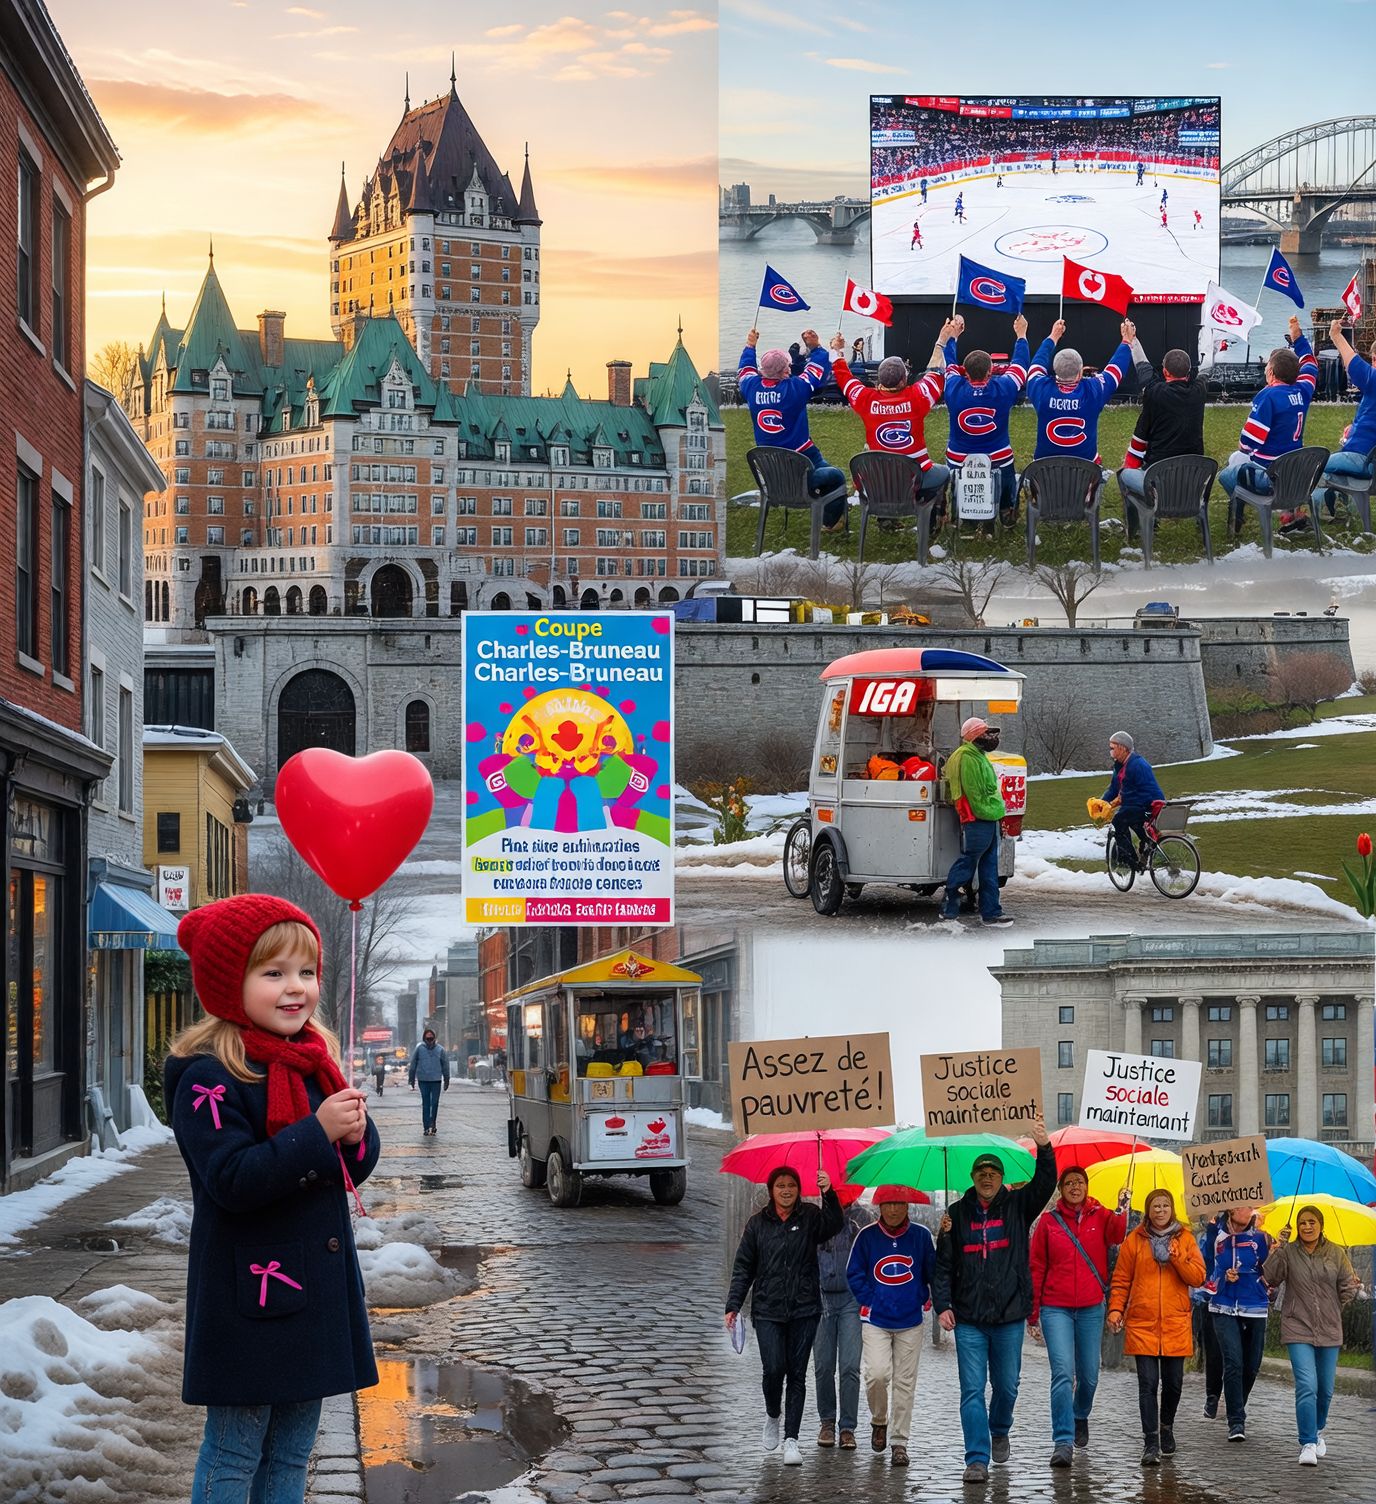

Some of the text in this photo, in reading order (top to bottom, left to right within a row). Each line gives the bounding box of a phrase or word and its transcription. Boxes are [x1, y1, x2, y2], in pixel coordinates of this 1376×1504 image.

[534, 617, 603, 640] Coupe
[477, 640, 661, 659] Charles-Bruneau
[474, 662, 663, 682] Charles-Bruneau
[858, 681, 917, 713] IGA
[742, 1040, 868, 1081] Assez de
[934, 1055, 1018, 1080] Justice
[1103, 1056, 1176, 1084] Justice
[947, 1078, 1012, 1102] sociale
[1105, 1085, 1169, 1107] sociale
